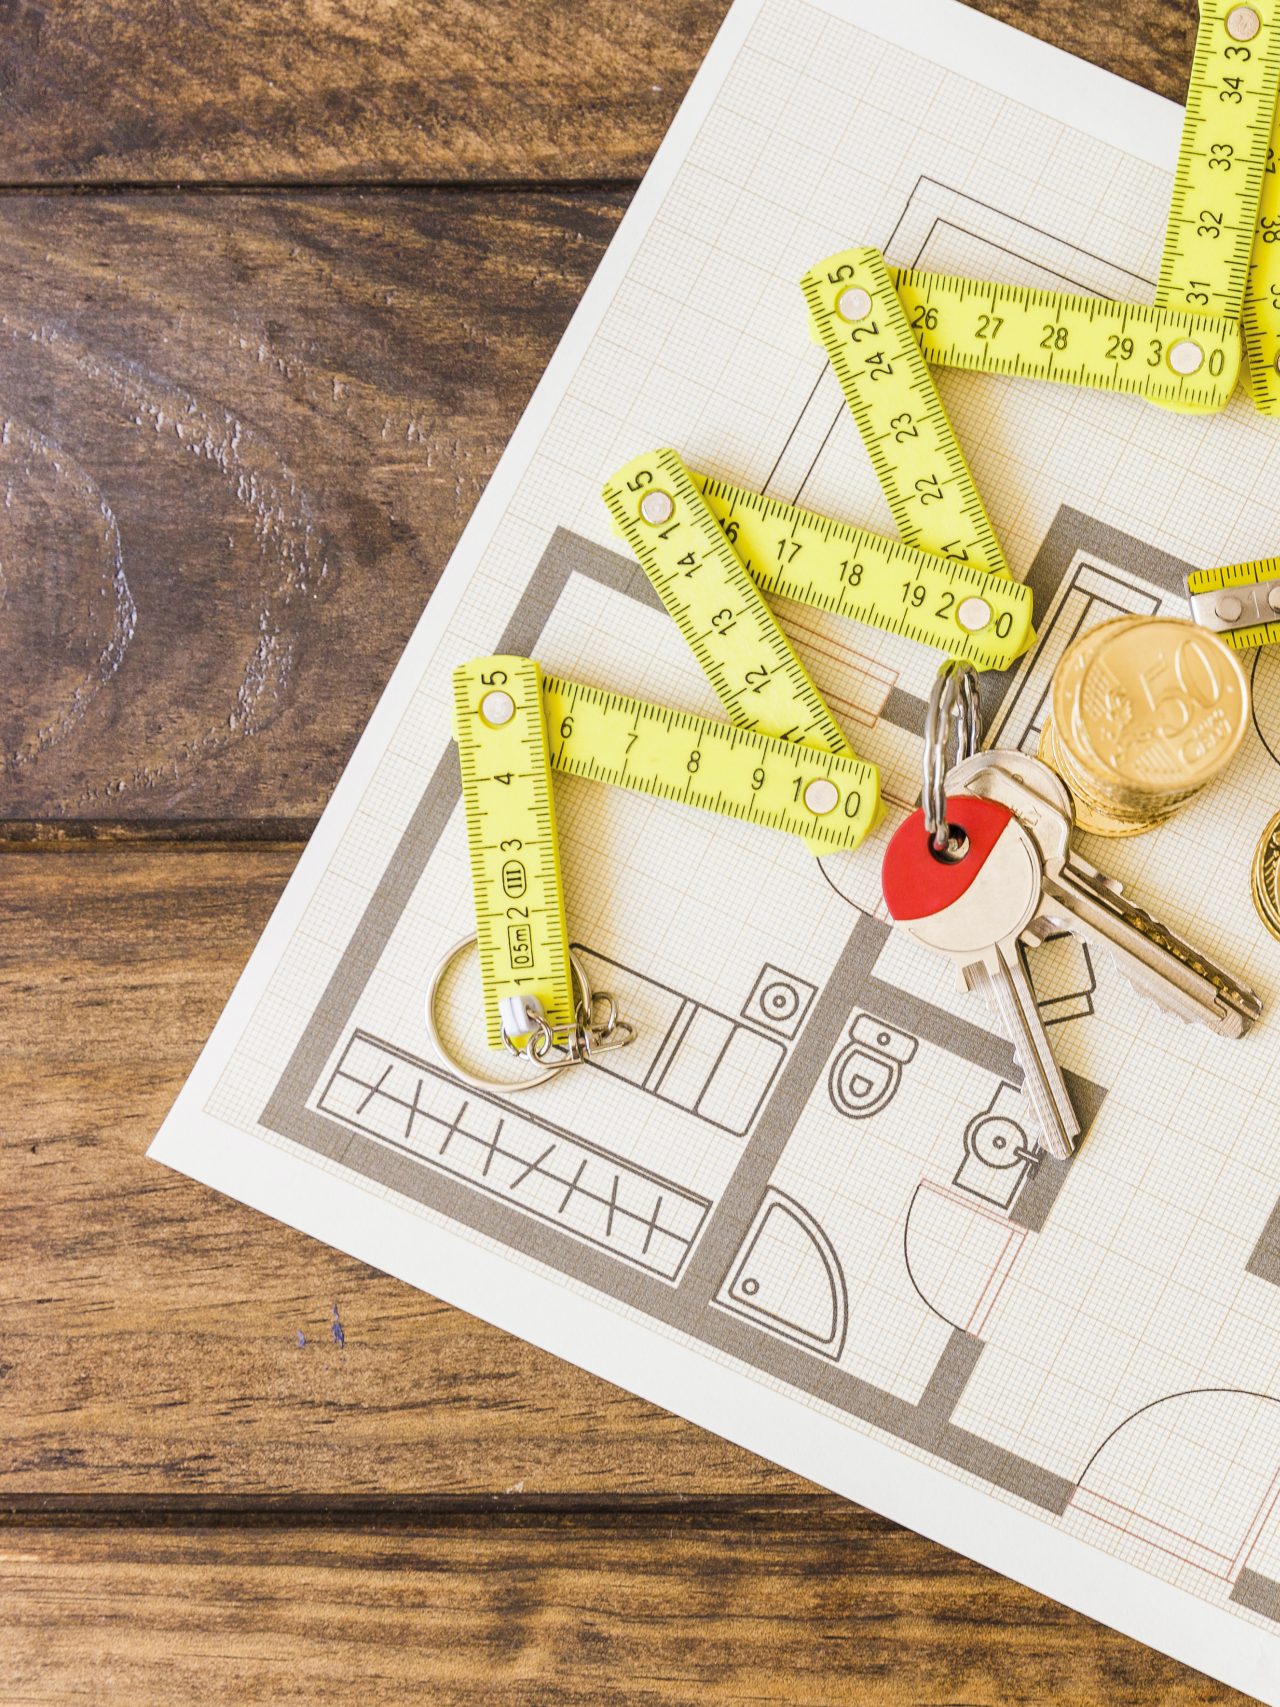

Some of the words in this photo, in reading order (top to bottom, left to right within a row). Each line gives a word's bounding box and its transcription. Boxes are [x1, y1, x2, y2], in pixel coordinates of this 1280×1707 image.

[1219, 77, 1244, 104] 34
[1208, 143, 1234, 172] 33
[1196, 210, 1223, 239] 32
[1185, 280, 1211, 306] 31
[911, 304, 939, 331] 26
[974, 315, 1004, 338] 27
[1039, 325, 1069, 351] 28
[1105, 335, 1134, 361] 29
[864, 351, 893, 381] 24
[890, 413, 919, 444] 23
[914, 474, 944, 506] 22
[676, 551, 703, 578] 14
[777, 539, 803, 563] 17
[839, 560, 864, 587] 18
[902, 582, 926, 608] 19
[711, 608, 737, 636] 13
[481, 670, 508, 686] 5
[745, 664, 771, 694] 12
[1139, 639, 1224, 738] 50
[560, 716, 574, 739] 6
[626, 733, 639, 755] 7
[686, 750, 701, 773] 8
[751, 768, 765, 791] 9
[493, 772, 514, 785] 4
[500, 839, 523, 852] 3
[506, 906, 529, 919] 2
[512, 929, 530, 964] 0.5m
[514, 977, 534, 986] 1
